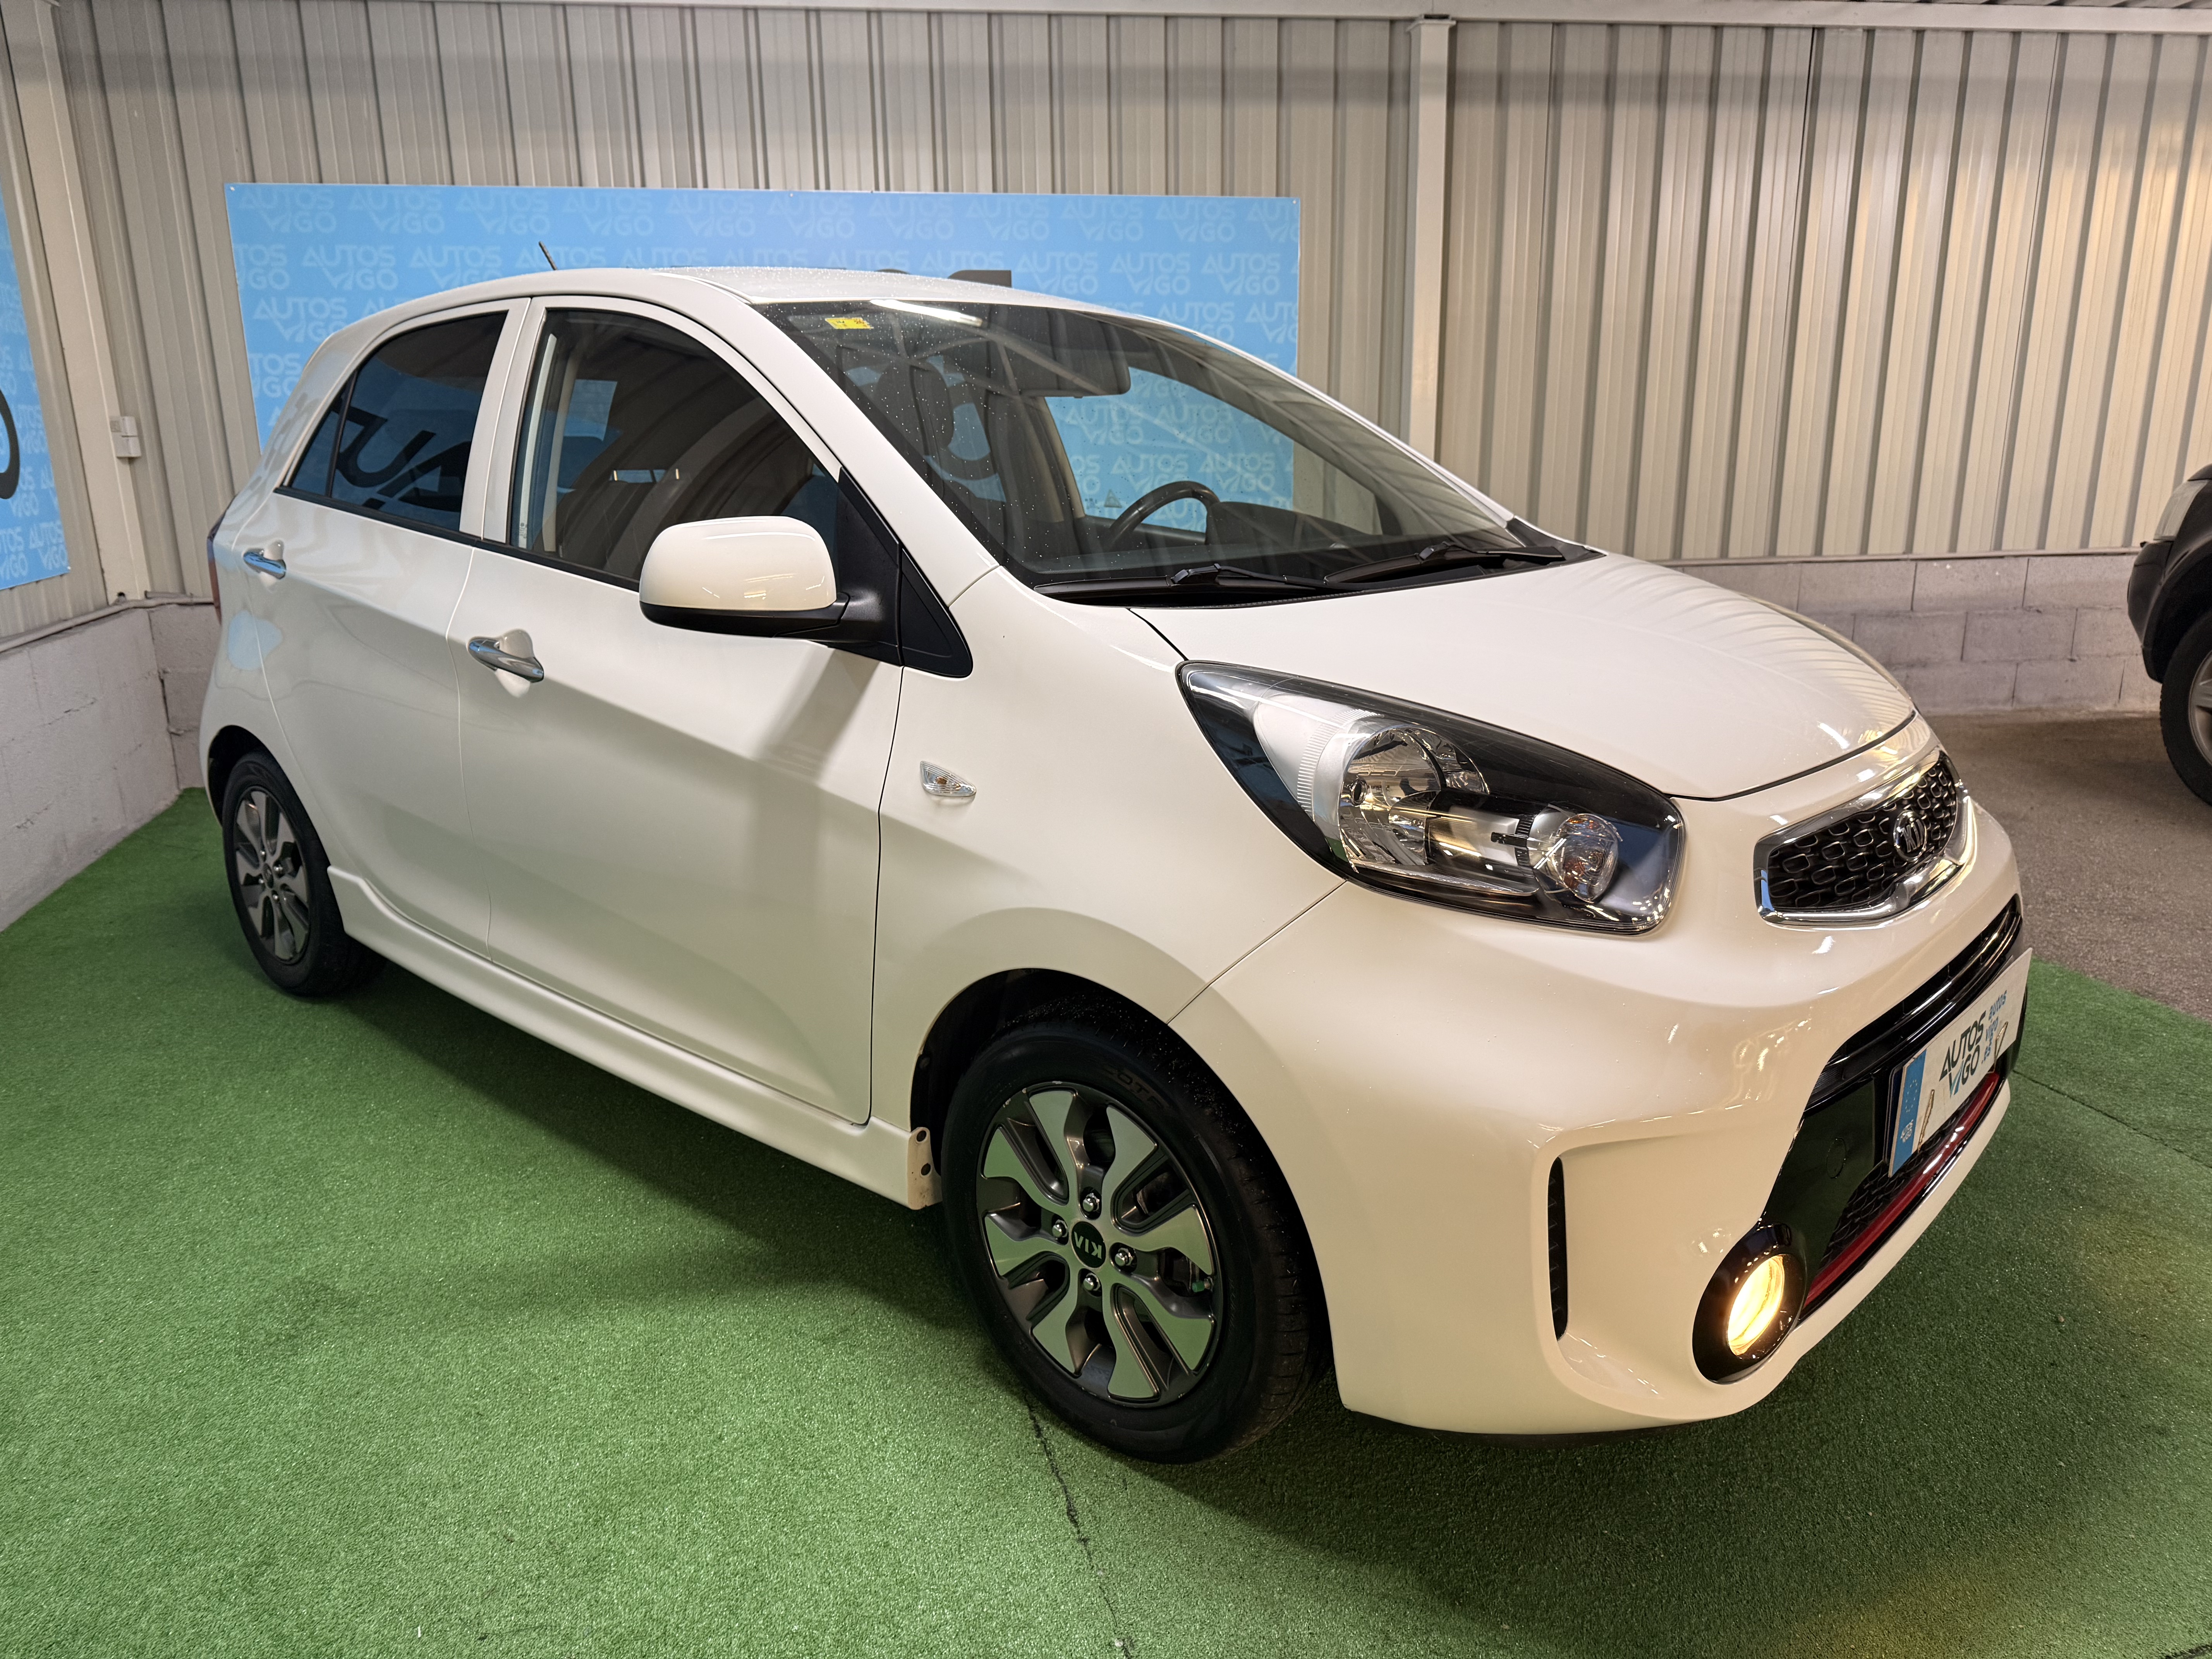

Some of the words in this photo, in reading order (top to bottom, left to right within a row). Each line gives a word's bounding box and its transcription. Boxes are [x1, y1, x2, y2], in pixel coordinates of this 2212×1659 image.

[238, 187, 335, 210] AUTOS
[349, 189, 442, 211] AUTOS
[455, 189, 549, 212] AUTOS
[562, 191, 653, 214] AUTOS
[665, 193, 754, 215] AUTOS
[767, 194, 855, 216] AUTOS
[868, 196, 953, 217] AUTOS
[965, 197, 1049, 218] AUTOS
[1060, 198, 1143, 219] AUTOS
[1155, 199, 1236, 221] AUTOS
[259, 210, 337, 233] VIGO
[366, 211, 445, 234] VIGO
[475, 213, 551, 235] VIGO
[581, 215, 654, 236] VIGO
[684, 215, 756, 237] VIGO
[785, 216, 855, 238] VIGO
[884, 217, 955, 240] VIGO
[984, 218, 1050, 241] VIGO
[1078, 220, 1144, 242] VIGO
[1172, 222, 1237, 243] VIGO
[301, 244, 396, 267] AUTOS
[408, 245, 503, 268] AUTOS
[919, 250, 1005, 271] AUTOS
[1014, 251, 1099, 273] AUTOS
[1109, 252, 1191, 274] AUTOS
[1200, 252, 1281, 274] AUTOS
[322, 268, 399, 290] VIGO
[1126, 275, 1191, 295] VIGO
[1217, 275, 1281, 295] VIGO
[252, 297, 348, 319] AUTOS
[1110, 454, 1189, 474] AUTOS
[1939, 1010, 1987, 1082] AUTOS
[1949, 1045, 1980, 1098] VIGO
[1074, 1231, 1102, 1259] KIA
